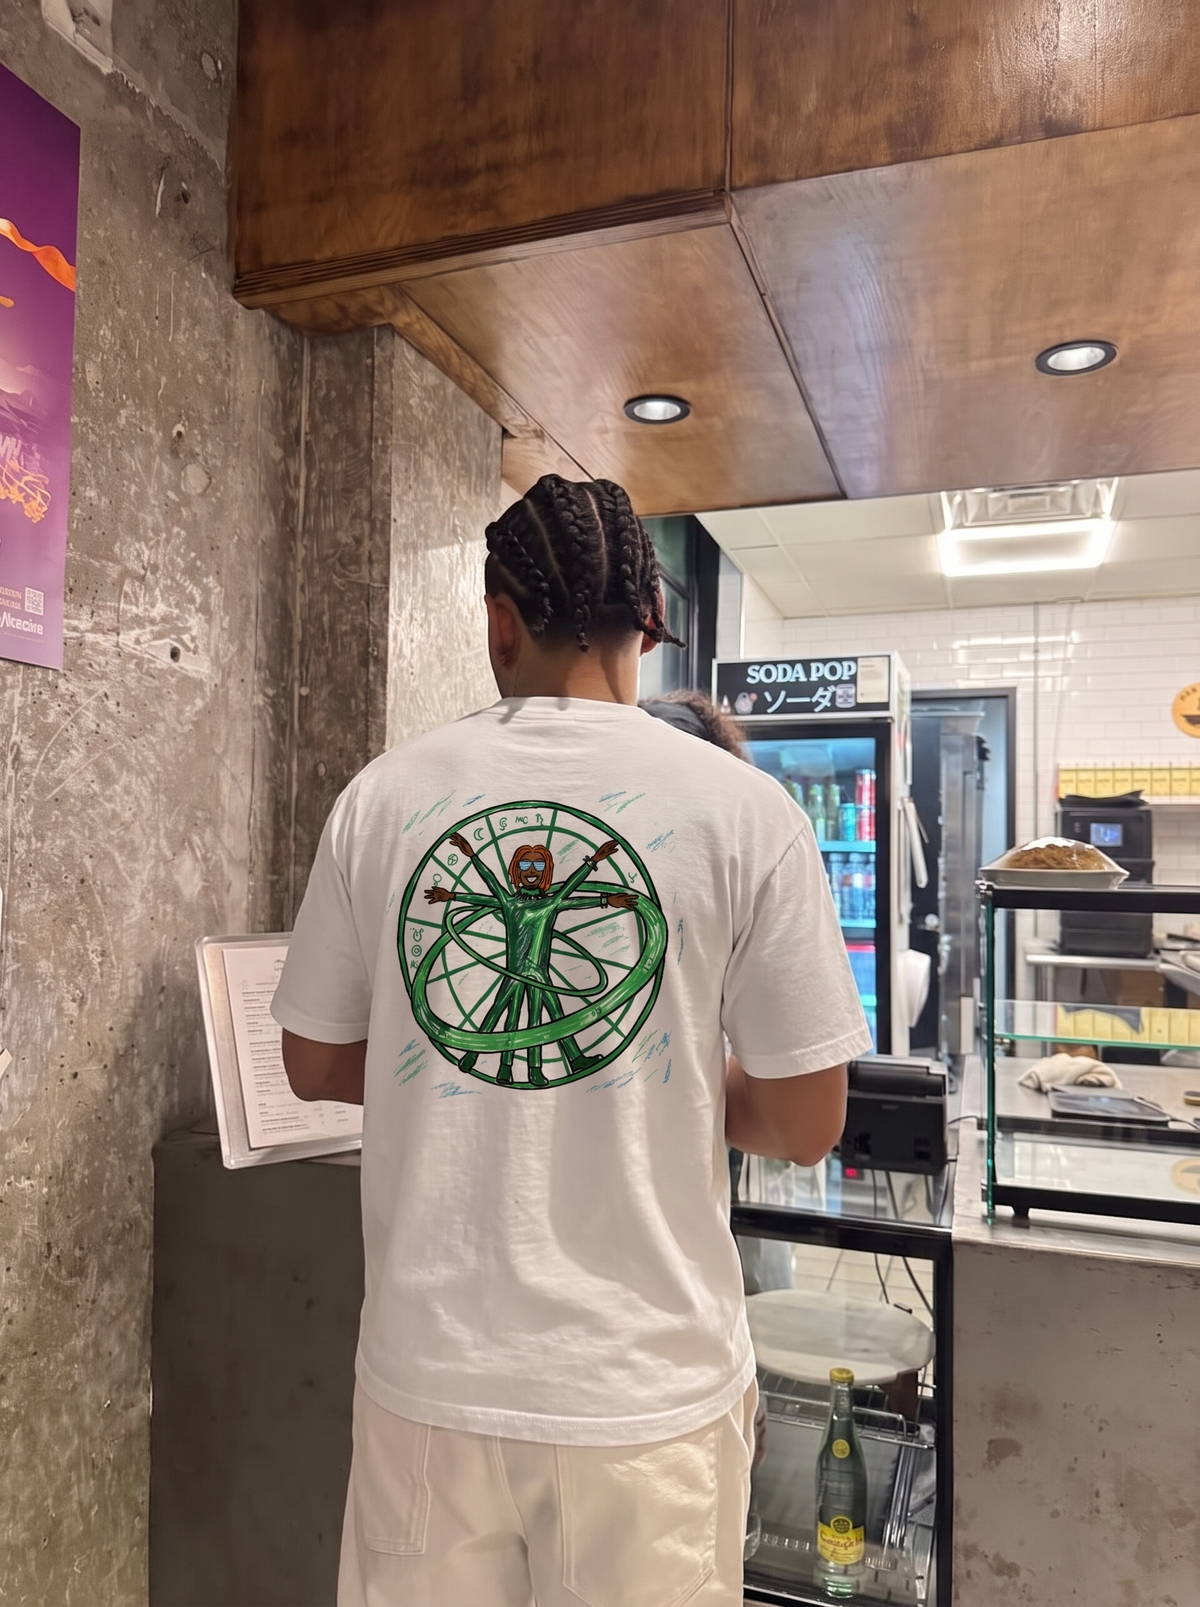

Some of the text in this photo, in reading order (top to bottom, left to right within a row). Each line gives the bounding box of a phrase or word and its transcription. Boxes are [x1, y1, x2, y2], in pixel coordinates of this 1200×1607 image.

[746, 662, 807, 684] SODA
[809, 661, 857, 682] POP
[763, 684, 837, 713] ソーダ
